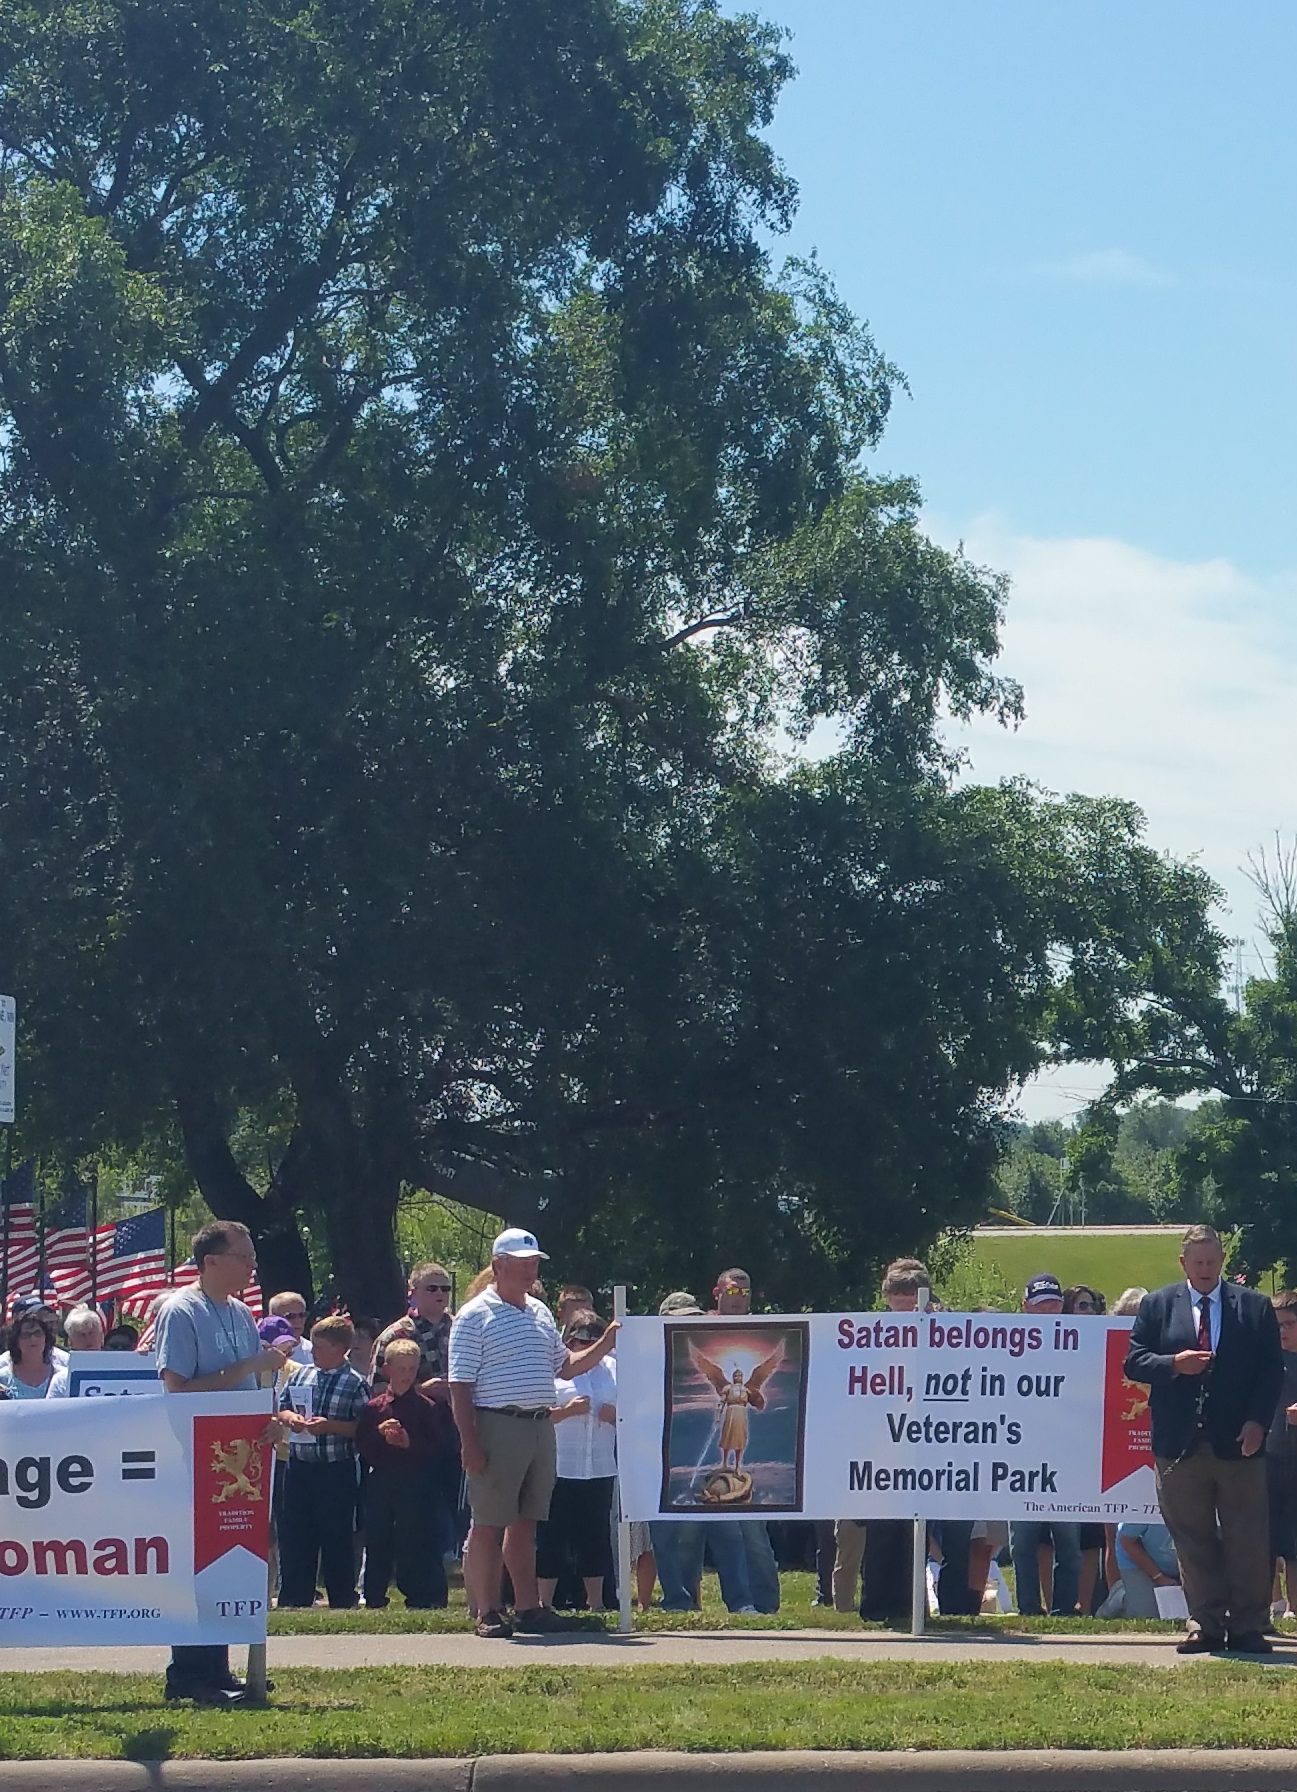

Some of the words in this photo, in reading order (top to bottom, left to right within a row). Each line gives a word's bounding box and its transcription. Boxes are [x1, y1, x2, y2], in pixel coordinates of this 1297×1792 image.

[837, 1318, 918, 1349] Satan
[929, 1318, 1042, 1357] belongs
[1054, 1321, 1079, 1350] in
[848, 1365, 913, 1402] Hell,
[924, 1366, 972, 1398] not
[981, 1366, 1005, 1397] in
[1017, 1374, 1065, 1398] our
[886, 1413, 1022, 1445] Veteran's
[0, 1455, 94, 1509] ge
[849, 1461, 979, 1492] Memorial
[991, 1462, 1058, 1493] Park
[1024, 1501, 1044, 1512] The
[1048, 1502, 1100, 1513] American
[1104, 1503, 1128, 1514] TFP
[1143, 1504, 1161, 1514] TF
[0, 1607, 33, 1619] TFP
[56, 1608, 161, 1620] WWW.TFP.ORG
[216, 1600, 262, 1617] TFP
